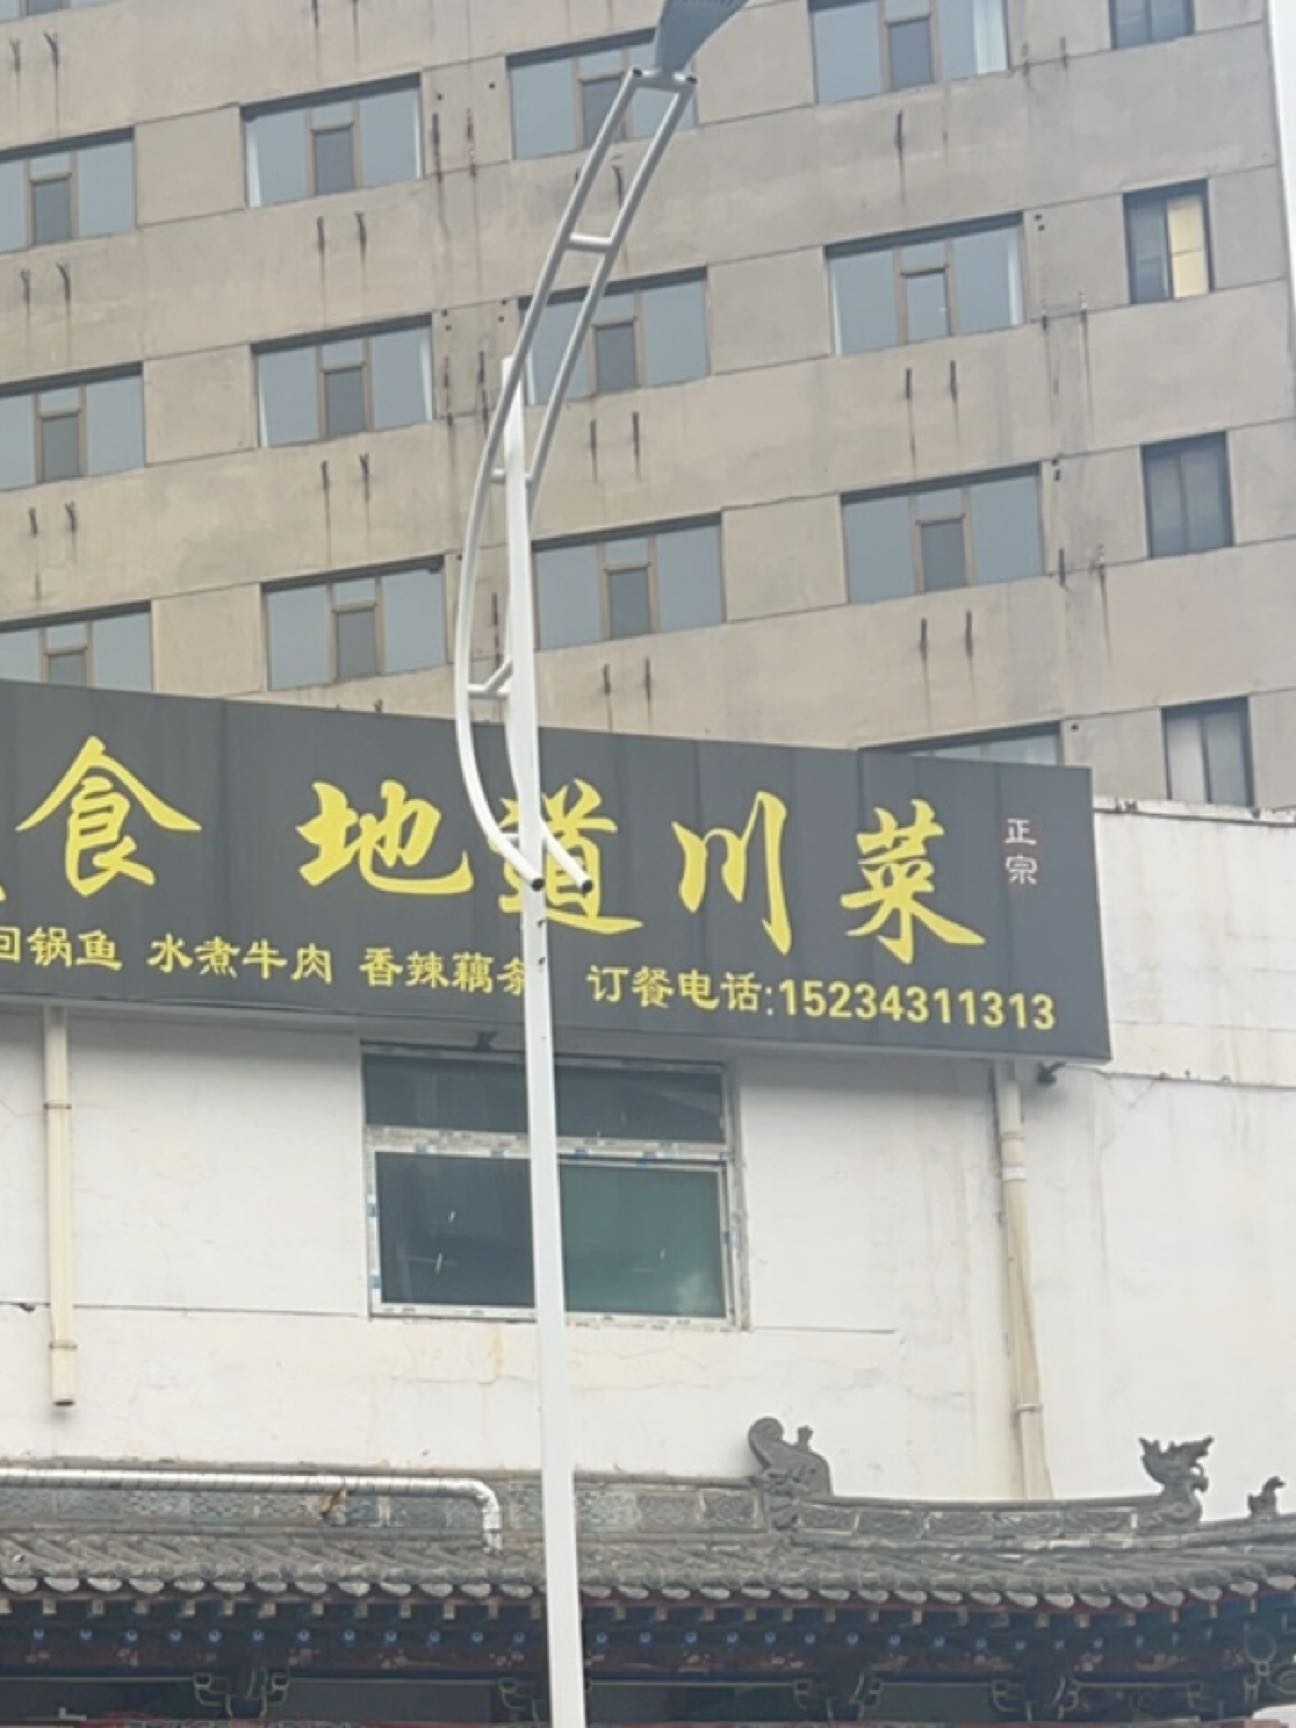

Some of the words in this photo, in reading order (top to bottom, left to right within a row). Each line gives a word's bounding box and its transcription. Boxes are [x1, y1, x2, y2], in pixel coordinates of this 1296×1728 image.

[297, 778, 986, 965] 地道川菜
[1004, 817, 1038, 885] 正宗
[148, 935, 334, 983] 水煮牛肉
